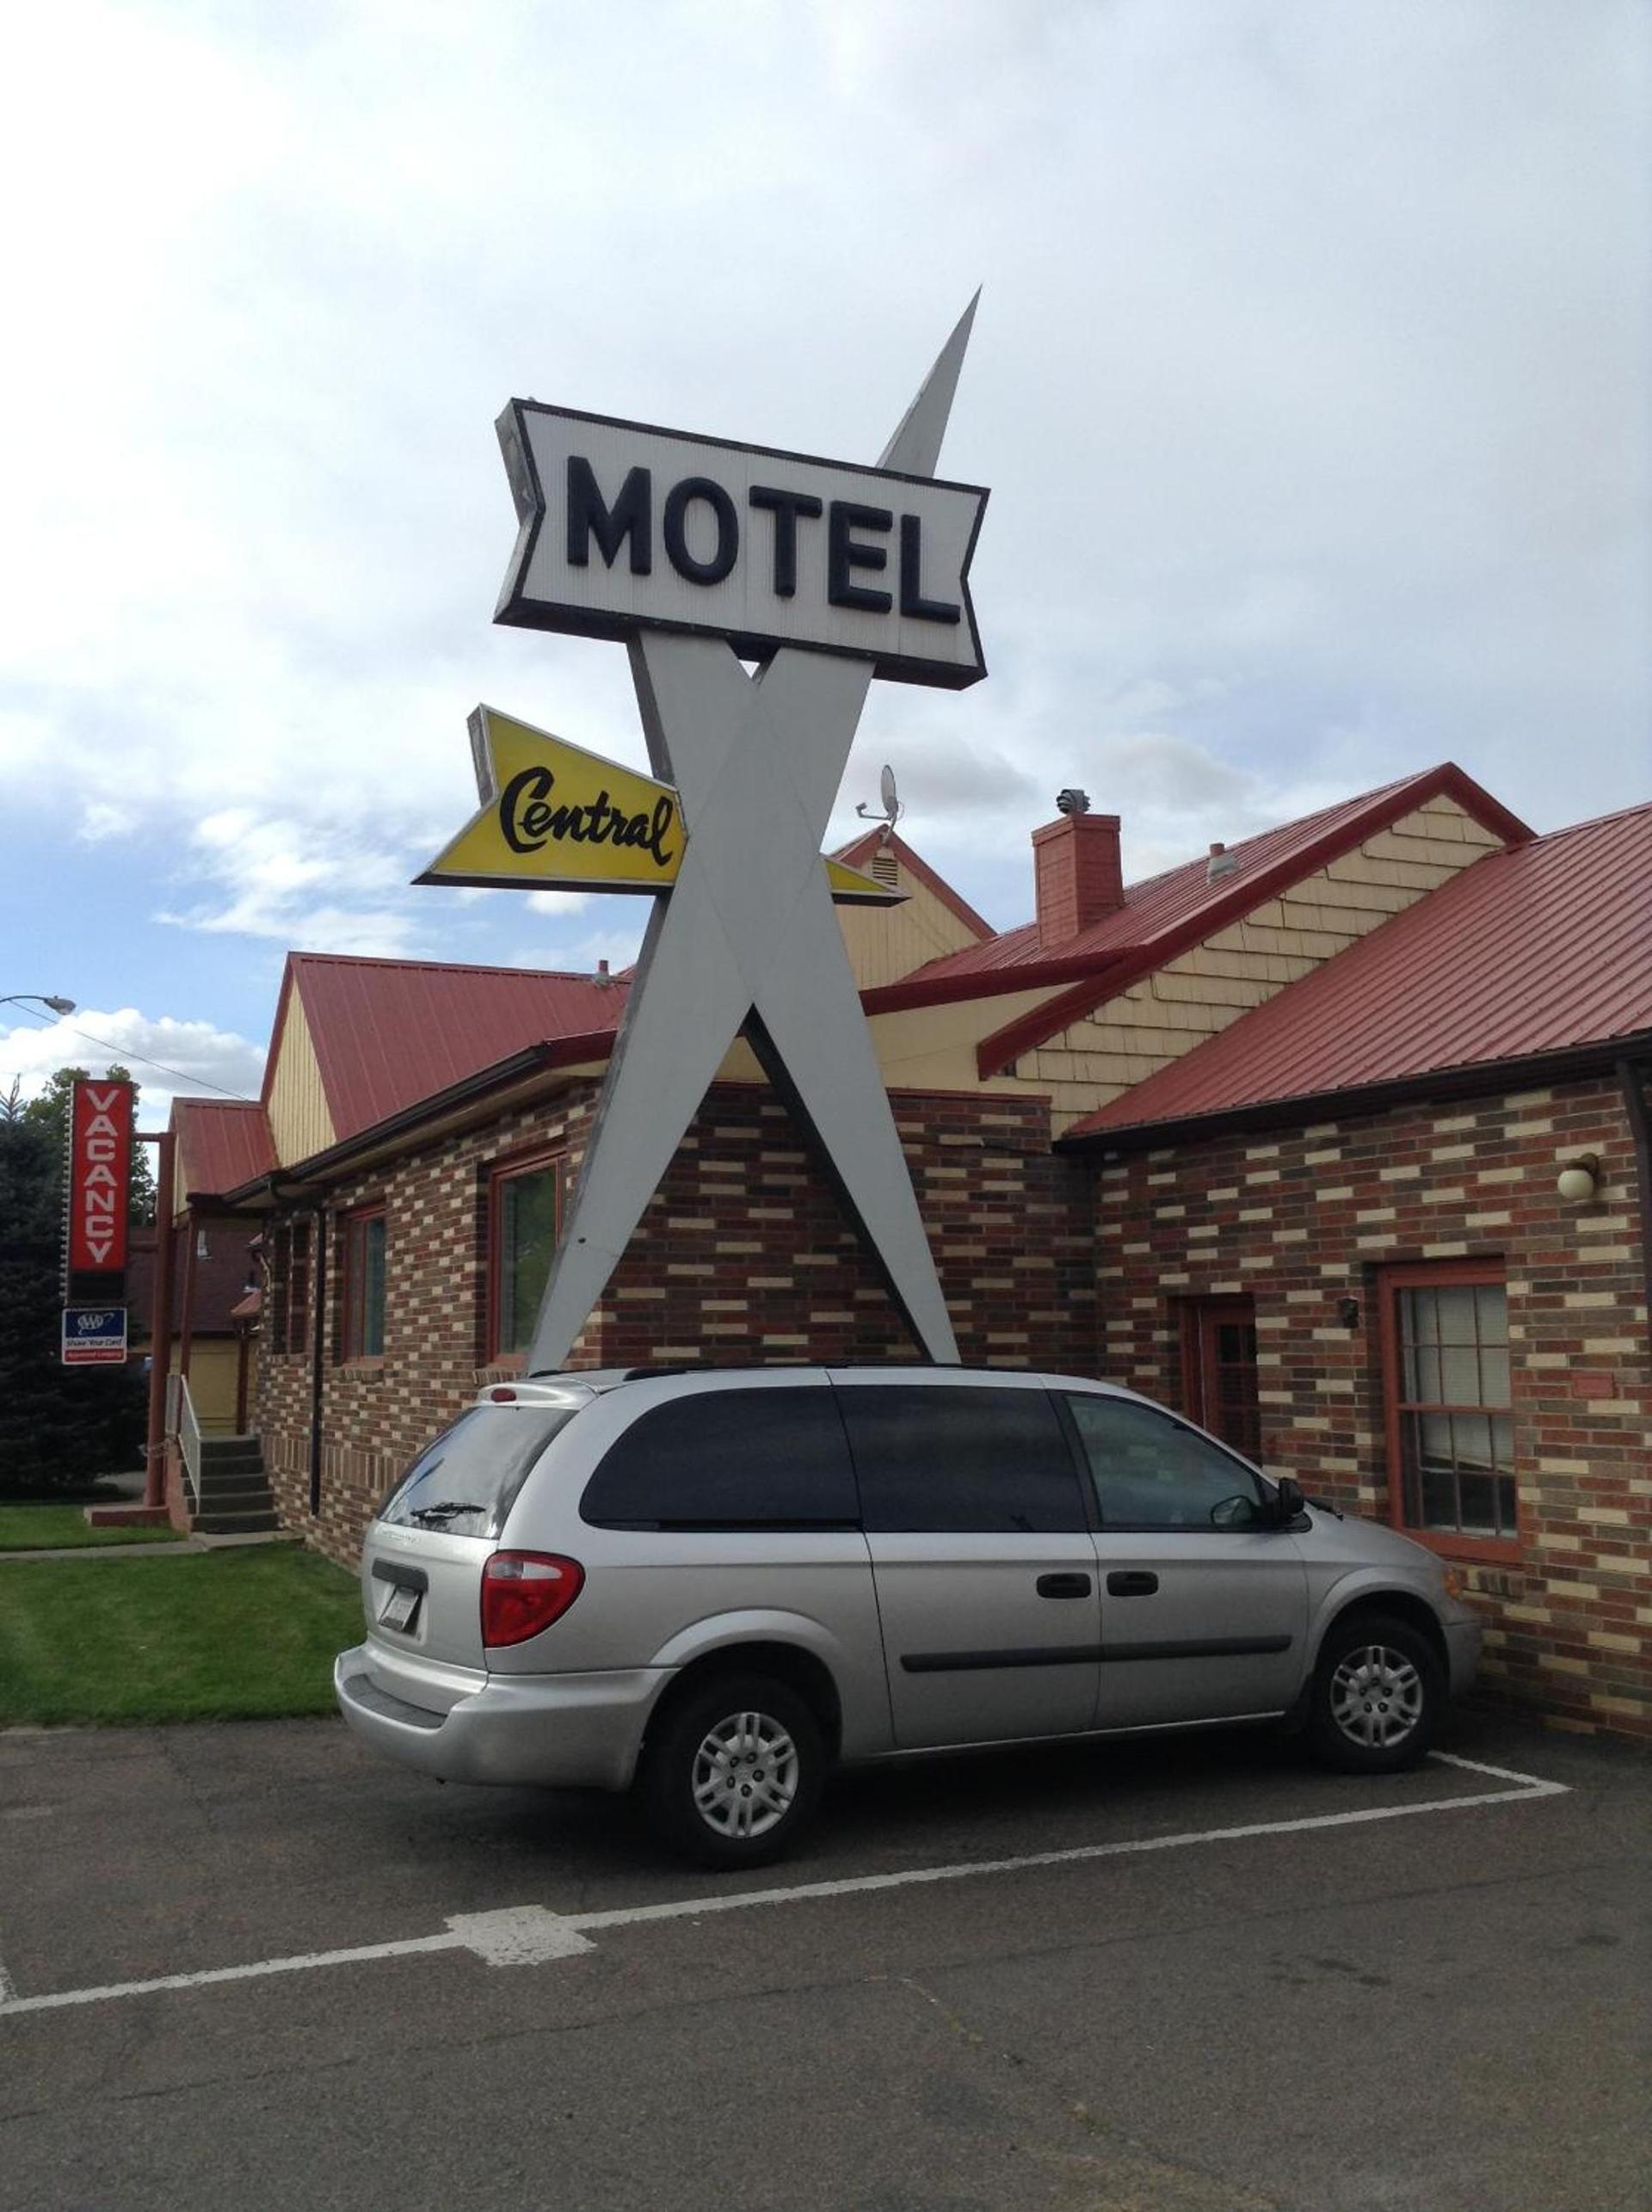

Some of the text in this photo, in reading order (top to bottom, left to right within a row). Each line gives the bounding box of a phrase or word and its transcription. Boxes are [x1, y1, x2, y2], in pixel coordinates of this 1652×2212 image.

[566, 454, 961, 625] MOTEL
[499, 767, 674, 866] Central
[83, 1089, 120, 1264] VACANCY
